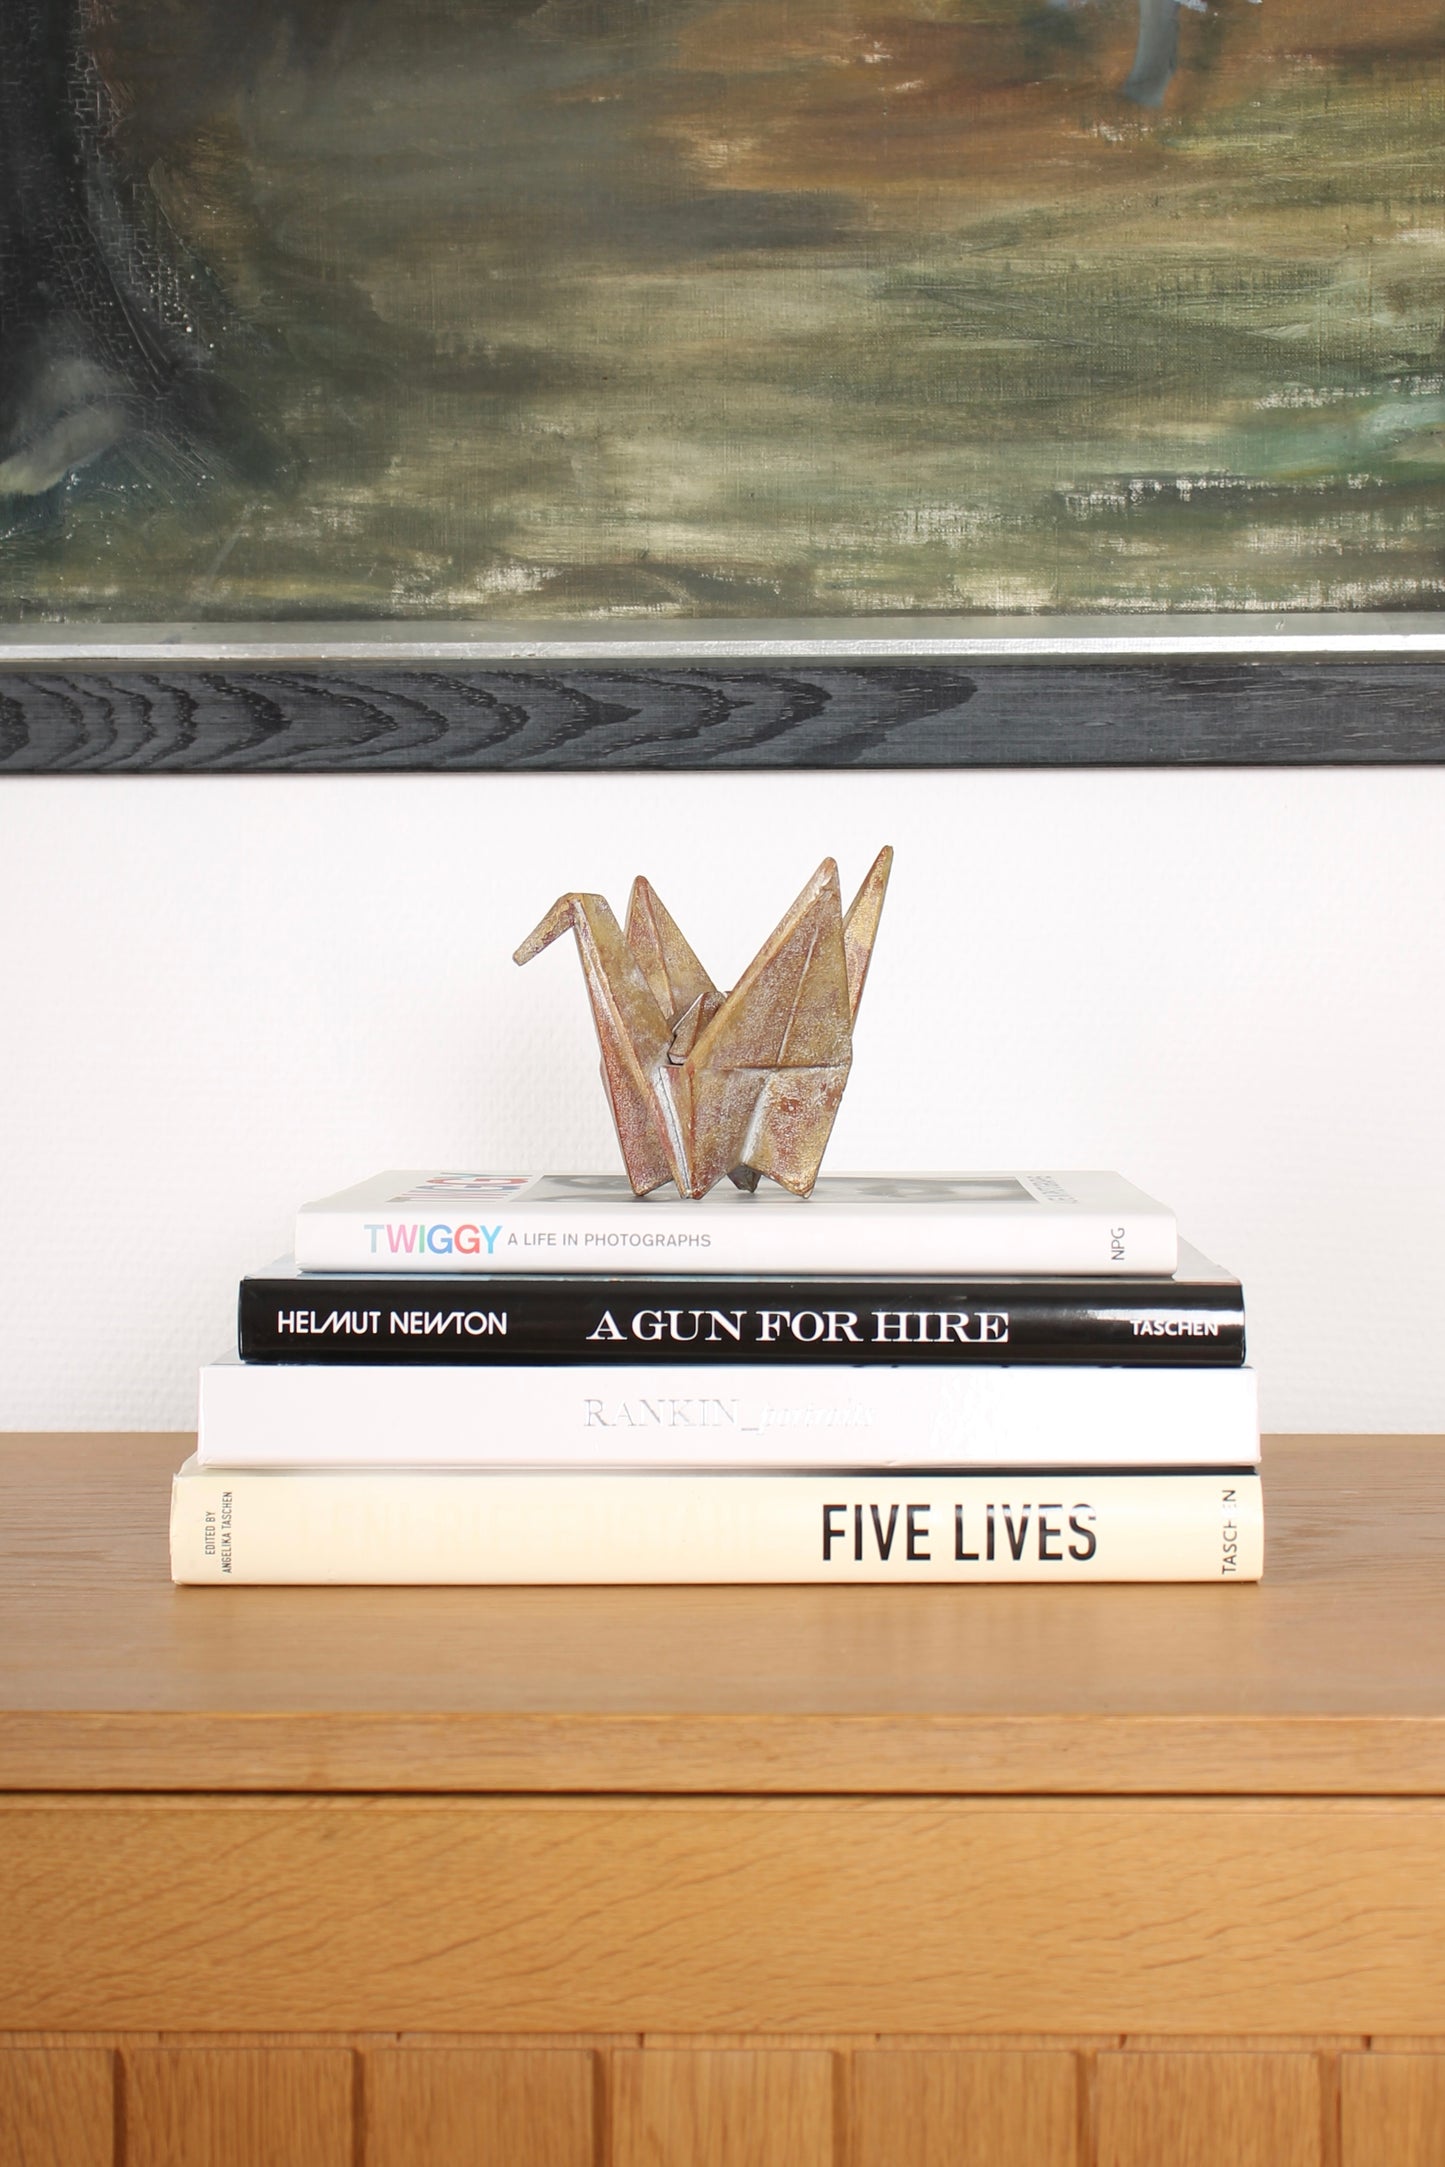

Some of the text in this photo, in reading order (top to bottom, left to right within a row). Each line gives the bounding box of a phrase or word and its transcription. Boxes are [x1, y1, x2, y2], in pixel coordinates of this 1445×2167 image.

[364, 1224, 712, 1254] TWIGGY A LIFE IN PHOTOGRAPHS
[1110, 1227, 1126, 1261] NPG
[277, 1310, 508, 1335] HELMUT NEWTON
[586, 1309, 1010, 1343] A GUN FOR HIRE
[1130, 1319, 1219, 1336] TASCHEN
[204, 1511, 216, 1555] EDITED BY
[221, 1491, 233, 1574] ANGELIKA TASCHEN
[823, 1503, 932, 1561] FIVE
[954, 1503, 1097, 1562] LIVES
[1221, 1489, 1238, 1575] TASCHN
